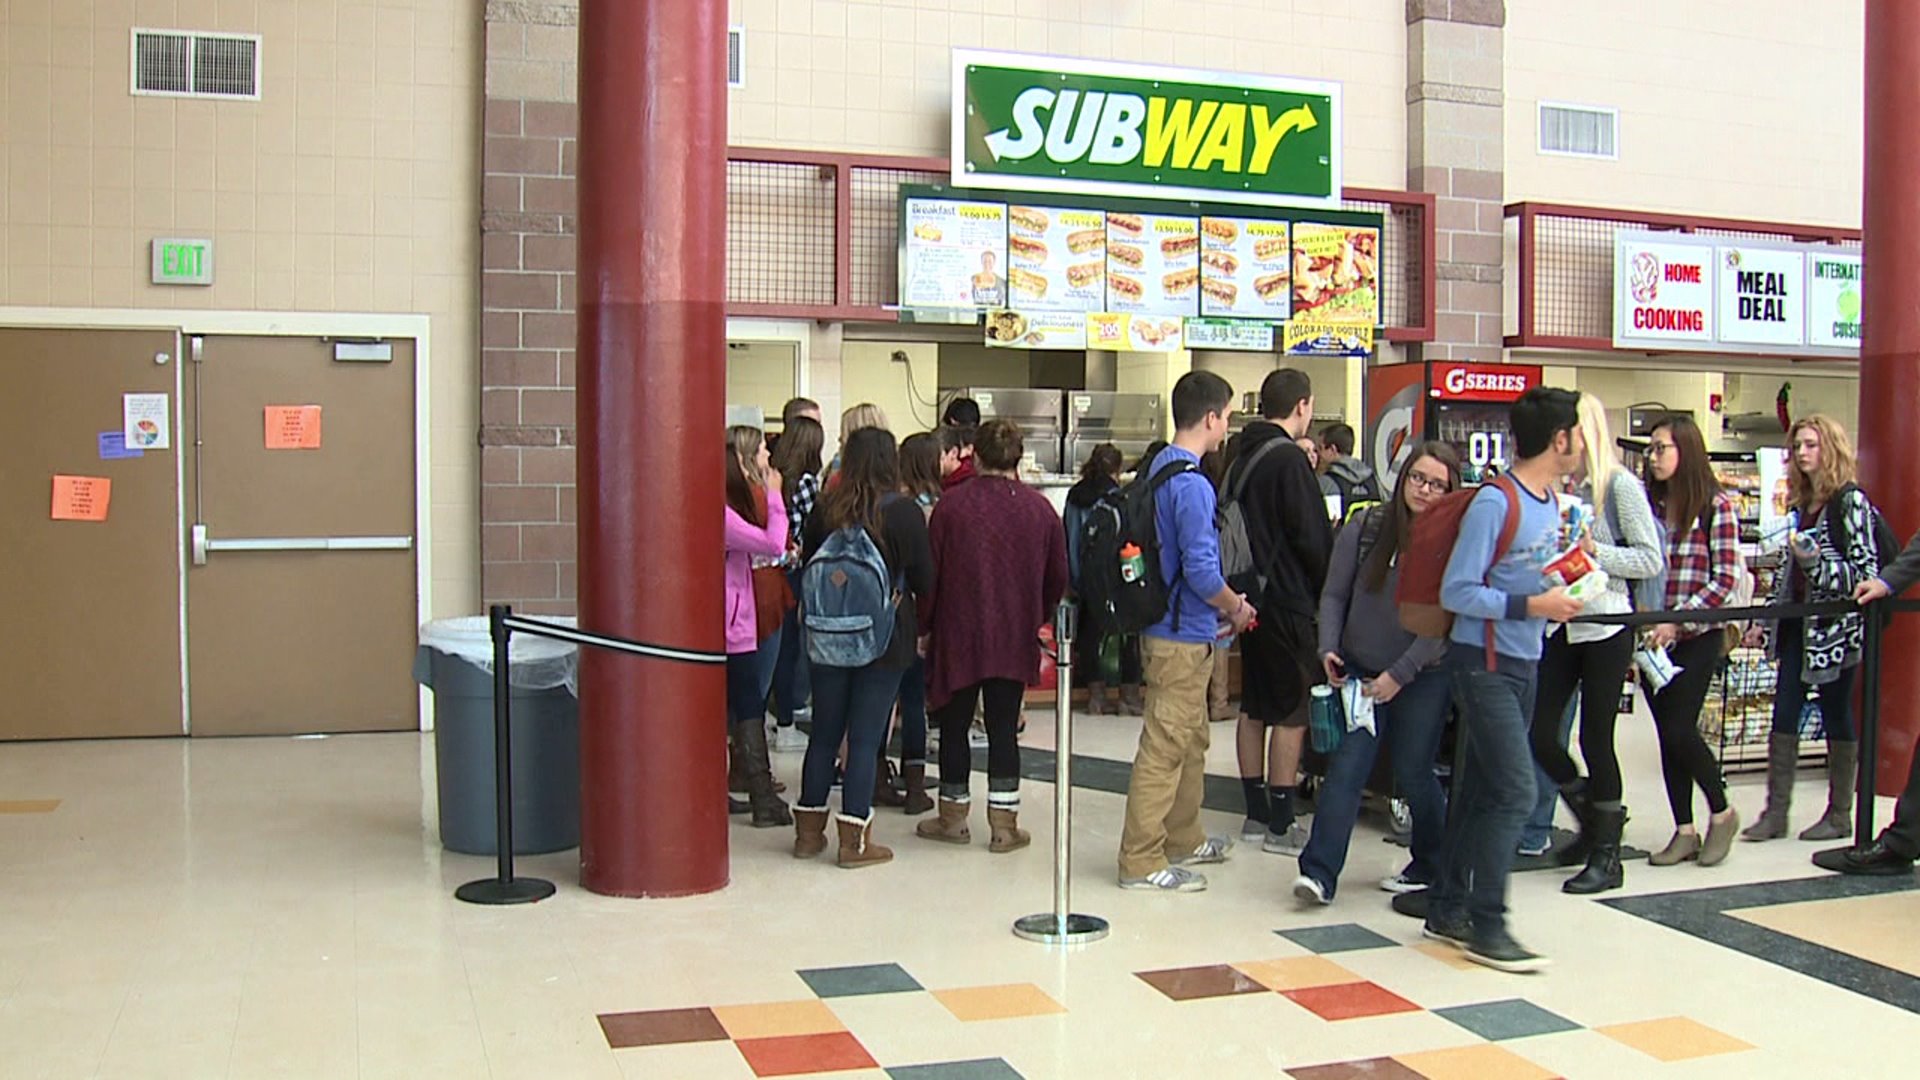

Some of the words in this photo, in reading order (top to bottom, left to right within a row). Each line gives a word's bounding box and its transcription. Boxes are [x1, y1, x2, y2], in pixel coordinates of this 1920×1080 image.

[984, 86, 1318, 175] SUBWAY
[163, 244, 204, 277] EXIT
[1664, 263, 1701, 284] HOME
[1737, 271, 1787, 296] MEAL
[1633, 307, 1703, 331] COOKING
[1738, 297, 1786, 322] DEAL
[1469, 432, 1506, 467] 01
